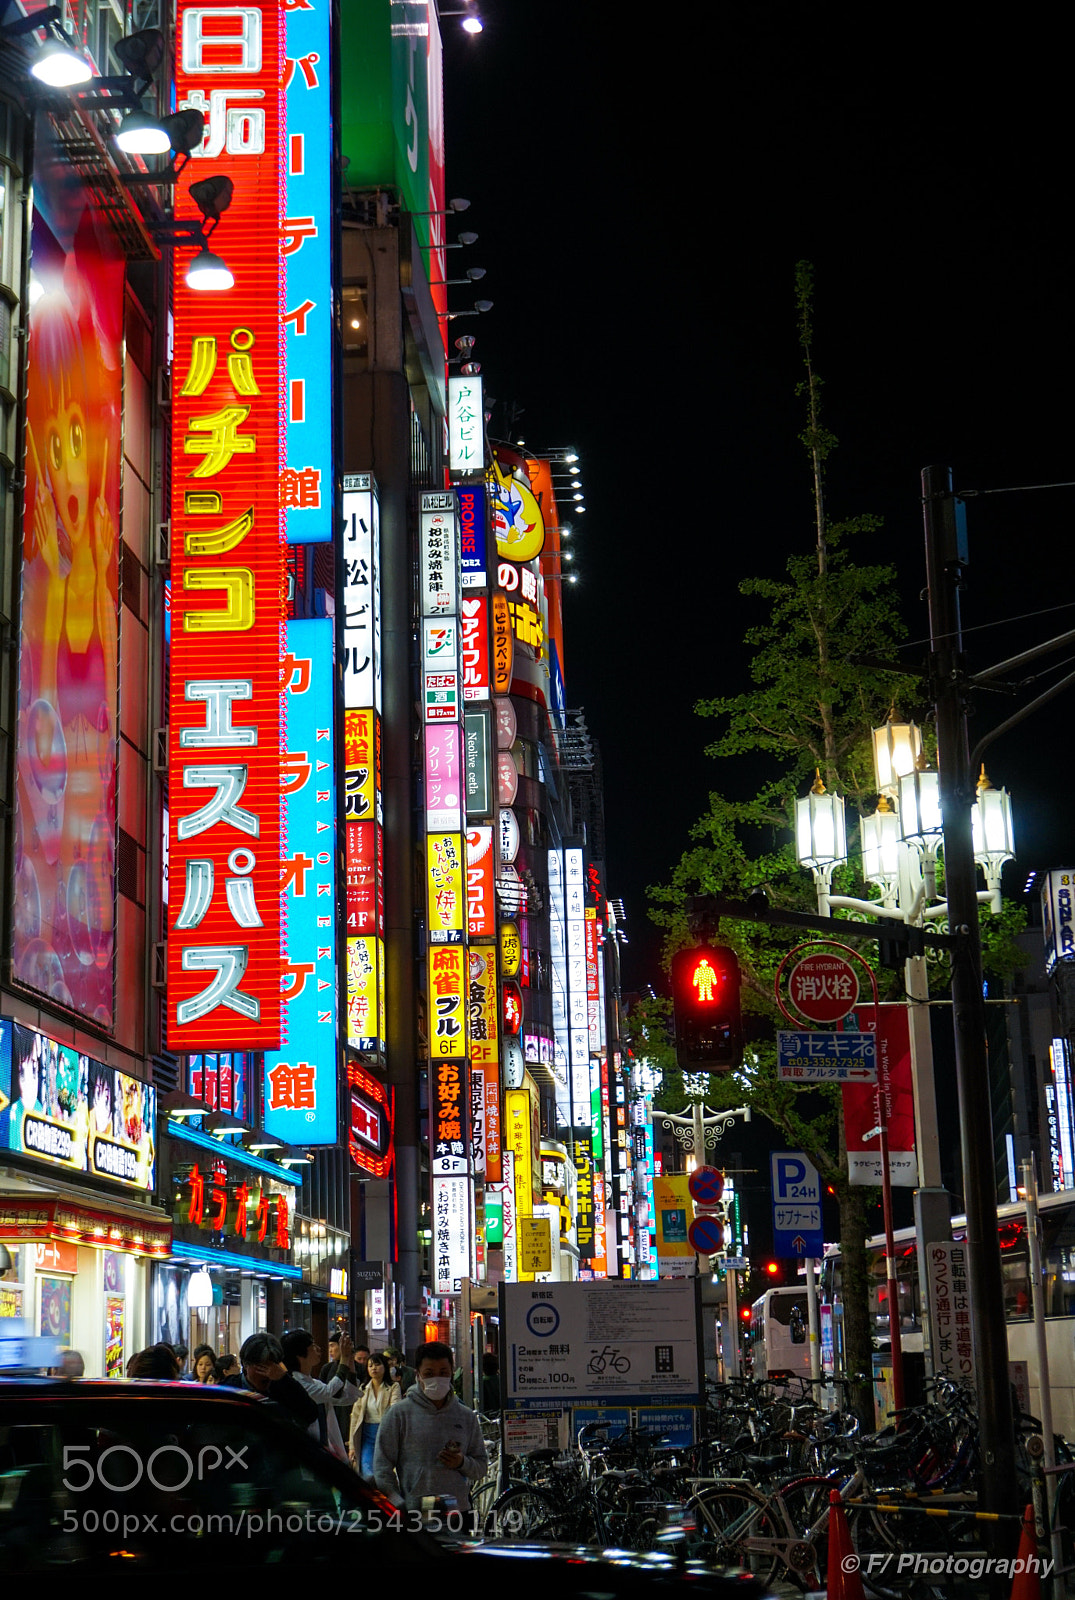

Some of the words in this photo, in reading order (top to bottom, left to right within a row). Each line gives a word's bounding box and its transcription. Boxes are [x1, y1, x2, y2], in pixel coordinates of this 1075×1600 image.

[179, 6, 267, 158] 日拓
[455, 386, 477, 460] 戸谷ビル
[179, 327, 262, 633] パチンコ
[461, 469, 474, 477] 7F
[423, 495, 453, 509] 小松ビル
[461, 493, 476, 553] PROMISE
[462, 575, 477, 585] 6F
[429, 606, 450, 614] 2F
[463, 618, 482, 685] アイフル
[427, 676, 456, 687] たばこ
[434, 691, 448, 703] 酒
[464, 690, 480, 699] 5F
[444, 729, 455, 778] フィラー
[467, 732, 478, 768] Neolive
[345, 712, 371, 816] 麻雀ブル
[428, 746, 442, 808] クリニック
[172, 679, 267, 1026] エスパス
[433, 842, 454, 884] もんじゃ
[442, 836, 460, 870] お好み
[315, 727, 333, 1024] KARAOKEKAN
[346, 874, 367, 885] 117
[430, 868, 445, 888] たこ
[467, 868, 486, 918] アコム
[347, 911, 369, 928] 4F
[435, 890, 456, 926] 焼き
[448, 930, 461, 942] 7F
[469, 921, 485, 933] 3F
[355, 939, 373, 974] お好み
[503, 938, 518, 966] 虎の子
[800, 963, 815, 971] FIRE
[815, 962, 845, 971] HYDRANT
[432, 948, 462, 1038] 麻雀ブル
[796, 974, 853, 1001] 消火栓
[361, 1037, 374, 1050] 7F
[439, 1040, 458, 1054] 6F
[471, 1045, 492, 1061] 2F
[880, 1038, 888, 1054] The
[796, 1058, 866, 1067] 03-3352-7325
[807, 1068, 849, 1078] アルタ裏
[882, 1056, 891, 1082] World
[885, 1083, 892, 1092] in
[437, 1063, 462, 1140] お好み焼
[486, 1104, 500, 1154] 焼き牛丼
[436, 1142, 465, 1155] 本陣
[441, 1158, 461, 1171] 8F
[853, 1160, 912, 1168] ラグビーワドカップ
[777, 1158, 807, 1198] P
[790, 1186, 816, 1198] 24H
[188, 1163, 289, 1250] カラオケ館
[777, 1209, 819, 1226] サブナード
[437, 1190, 451, 1280] お好み焼き本陣
[640, 1229, 648, 1260] TSUTAYA
[531, 1291, 554, 1299] 新宿区
[532, 1316, 554, 1325] 自転車
[932, 1248, 954, 1377] ゆっくり通行しましょ
